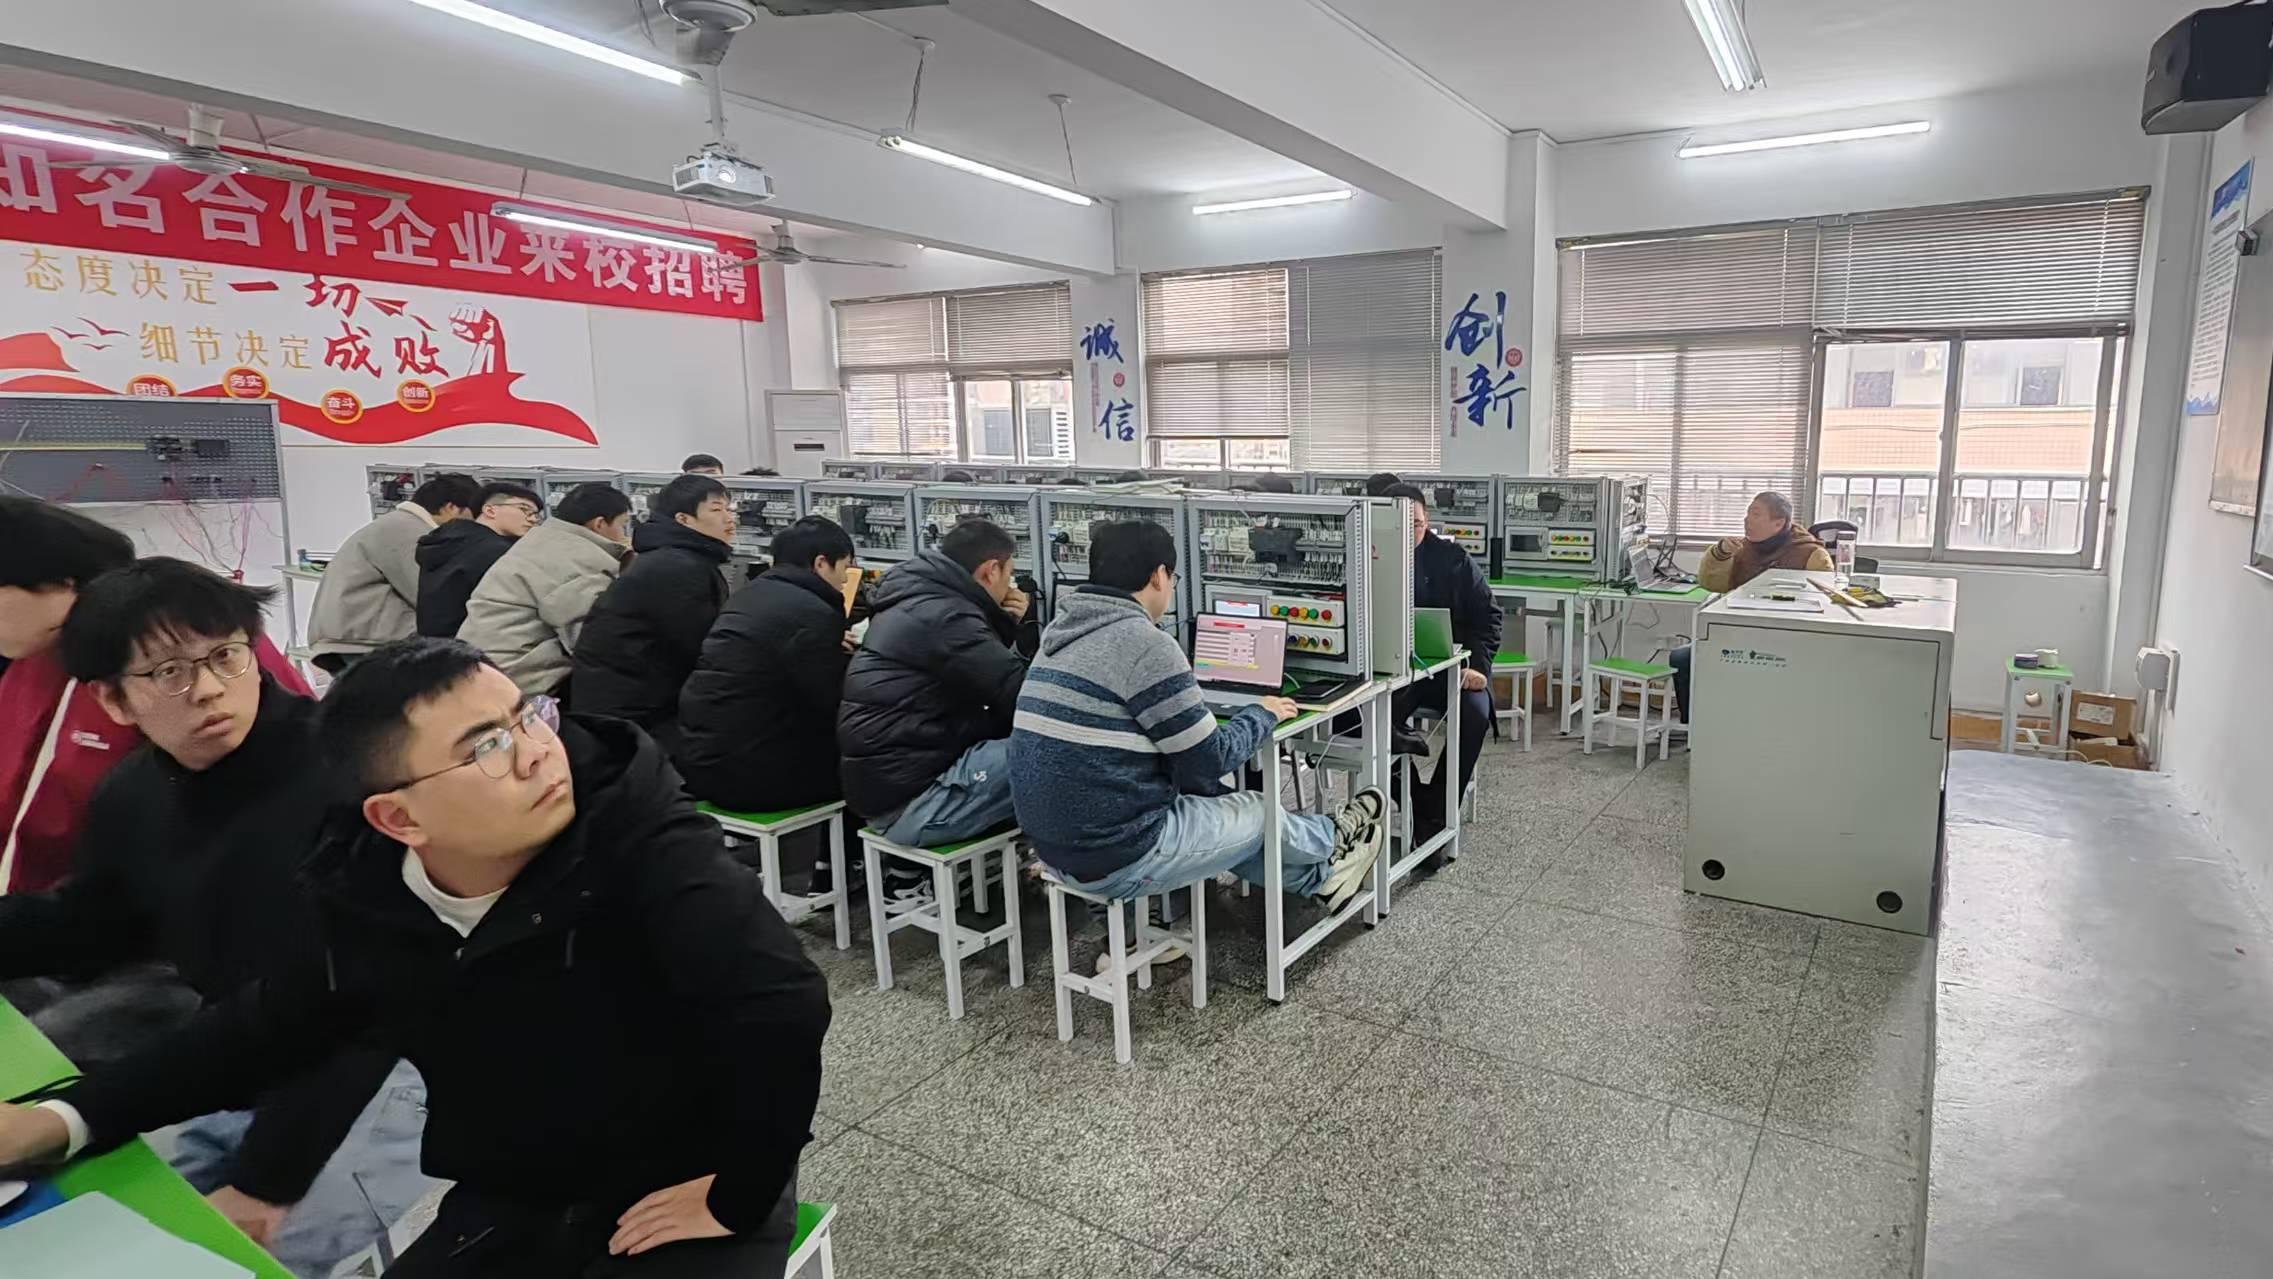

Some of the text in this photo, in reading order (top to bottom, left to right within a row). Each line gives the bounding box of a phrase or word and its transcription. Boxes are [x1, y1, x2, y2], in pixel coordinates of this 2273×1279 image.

[1444, 291, 1527, 430] 创新
[230, 374, 262, 387] 务实
[1080, 318, 1135, 442] 诚信
[133, 383, 169, 396] 团结
[402, 386, 429, 398] 创新
[327, 397, 355, 409] 奋斗
